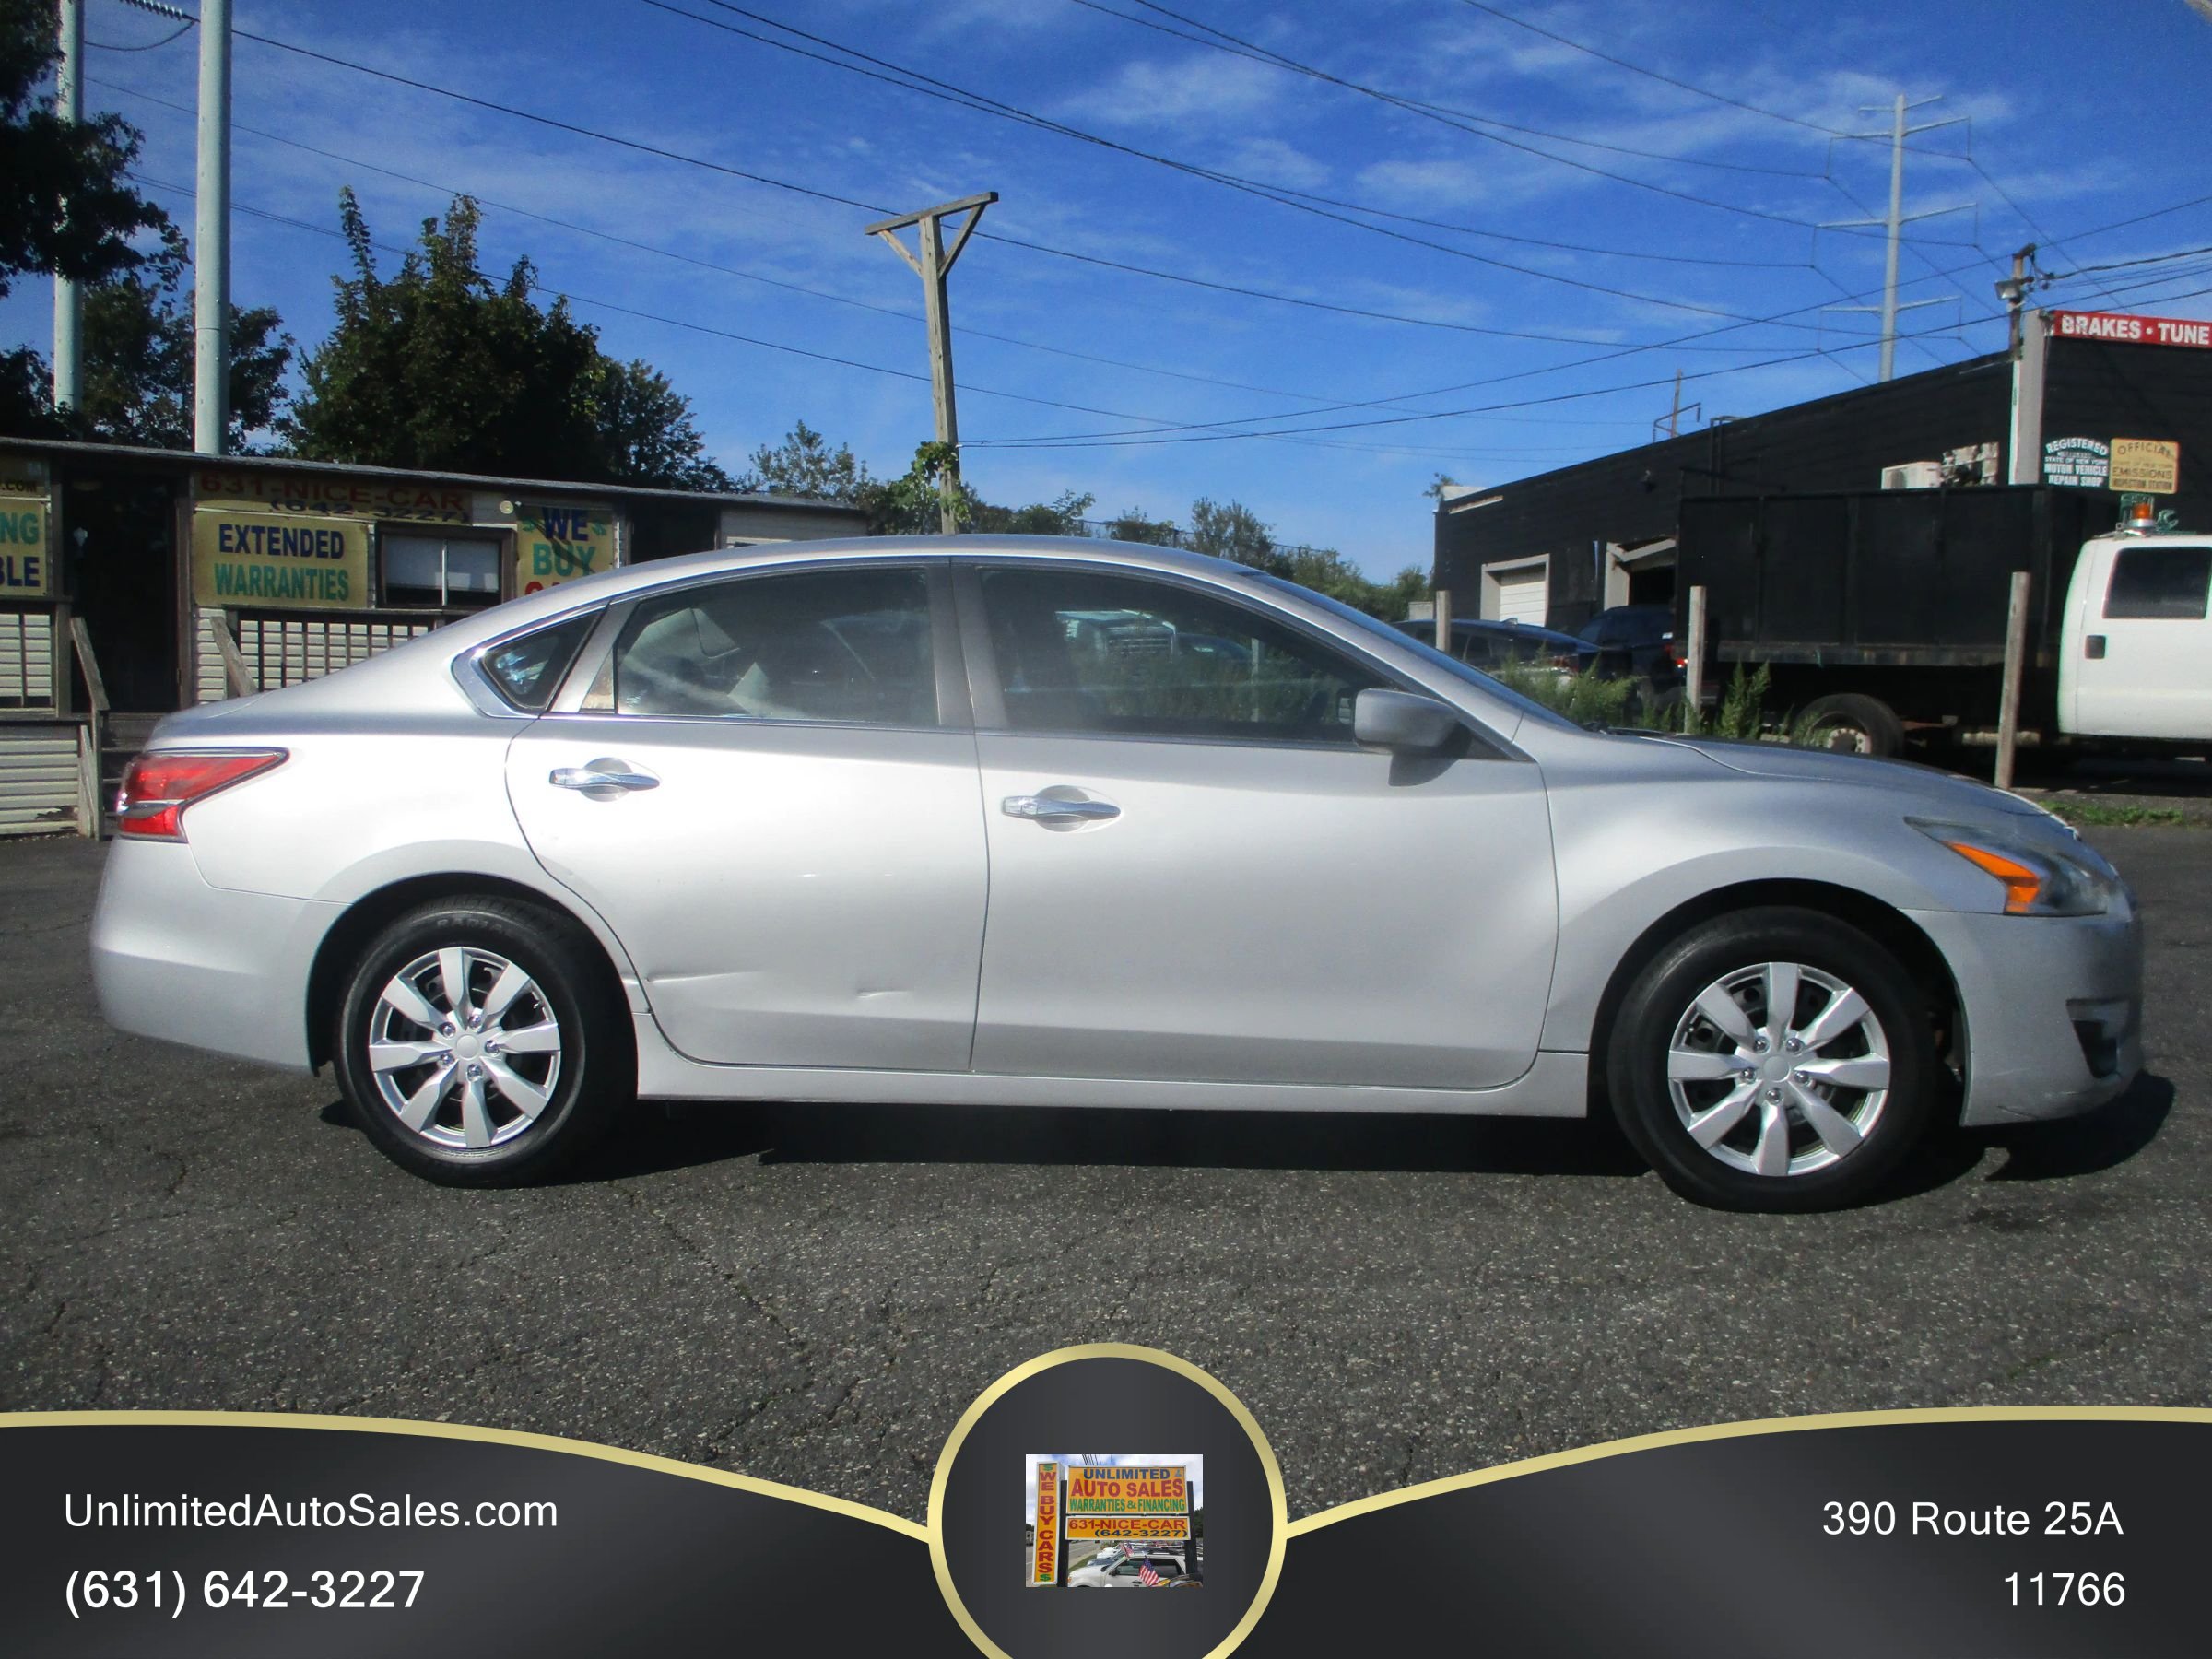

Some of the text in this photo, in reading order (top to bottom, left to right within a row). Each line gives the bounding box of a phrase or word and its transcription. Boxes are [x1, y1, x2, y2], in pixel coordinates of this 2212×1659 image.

[2061, 314, 2210, 345] BRAKES TUNE
[2045, 437, 2109, 456] REGISTERED
[2048, 474, 2079, 486] REPAIR
[2075, 464, 2108, 477] VEHICLE
[201, 473, 465, 512] 631-NICE-CAR
[218, 523, 345, 559] EXTENDED
[542, 507, 589, 541] WE
[533, 543, 596, 577] BUY
[214, 563, 349, 601] WARRANTIES
